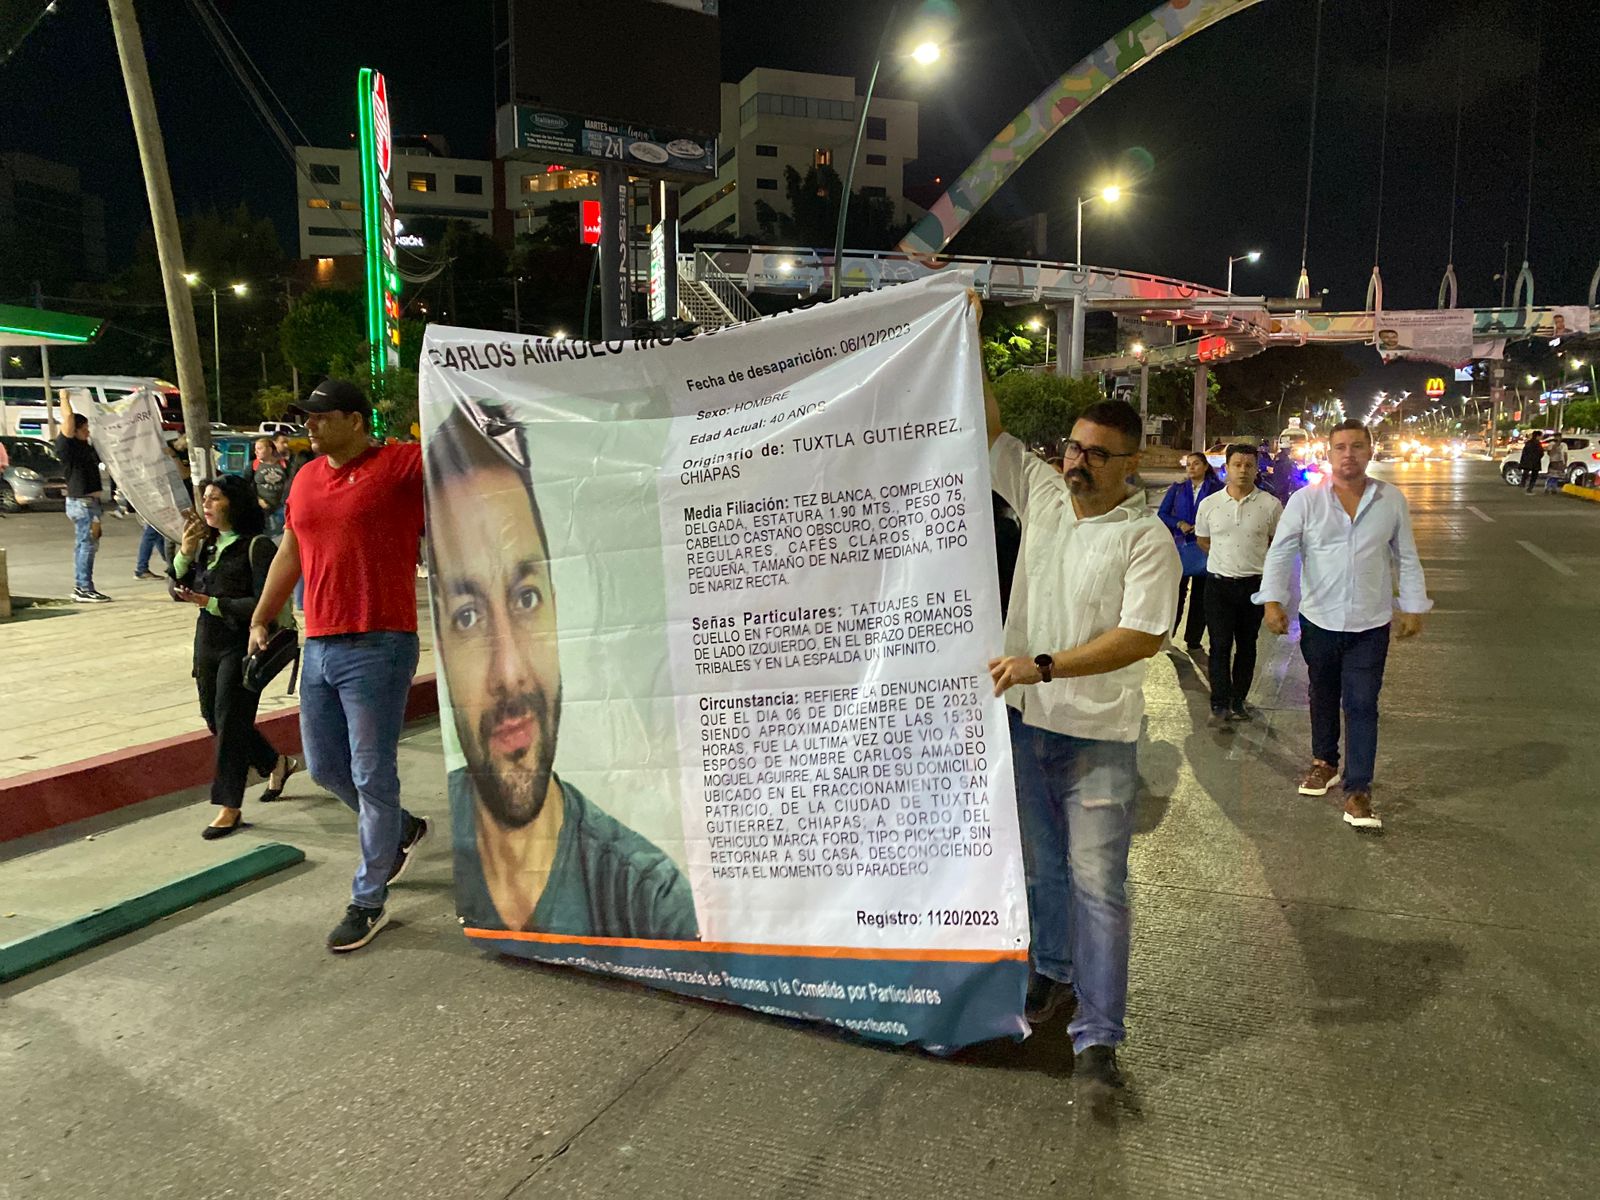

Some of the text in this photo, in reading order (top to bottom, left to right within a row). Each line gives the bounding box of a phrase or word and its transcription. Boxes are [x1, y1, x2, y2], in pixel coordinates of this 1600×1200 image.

[584, 119, 608, 132] MARTES
[686, 322, 912, 392] Fecha de desaparición: 06/12/2023
[696, 390, 790, 421] Sexo: HOMBRE
[689, 400, 826, 445] Edad Actual: 40 AÑOS
[682, 447, 753, 470] Originario
[761, 442, 784, 457] de:
[792, 432, 855, 452] TUXTLA
[680, 464, 740, 485] CHIAPAS
[683, 504, 722, 521] Media
[726, 496, 789, 516] Filiación:
[793, 493, 818, 508] TEZ
[879, 473, 963, 499] COMPLEXIÓN
[753, 507, 823, 528] ESTATURA
[829, 504, 856, 519] 1.90
[905, 492, 940, 511] PESO
[686, 532, 740, 551] CABELLO
[743, 524, 803, 544] CASTAÑO
[930, 503, 965, 520] OJOS
[788, 535, 837, 554] CAFÉS
[925, 519, 967, 537] BOCA
[751, 554, 805, 572] TAMAÑO
[808, 552, 827, 567] DE
[830, 544, 871, 564] NARIZ
[935, 533, 968, 550] TIPO
[689, 581, 705, 594] DE
[707, 577, 743, 592] NARIZ
[692, 589, 971, 631] Señas Particulares: TATUAJES EN EL
[692, 604, 972, 646] CUELLO EN FORMA DE NUMEROS ROMANOS
[694, 647, 712, 660] DE
[713, 644, 746, 659] LADO
[823, 636, 841, 649] EN
[844, 634, 861, 647] EL
[864, 627, 904, 645] BRAZO
[907, 620, 974, 640] DERECHO
[695, 658, 751, 675] TRIBALES
[753, 657, 762, 670] Y
[765, 656, 782, 669] EN
[784, 655, 801, 668] LA
[803, 649, 862, 666] ESPALDA
[864, 647, 880, 660] UN
[699, 675, 978, 711] Circunstancia: REFIERE DENUNCIANTE
[700, 711, 727, 727] QUE
[730, 710, 749, 725] EL
[756, 709, 779, 723] DIA
[785, 707, 801, 720] 06
[808, 705, 826, 719] DE
[833, 698, 907, 717] DICIEMBRE
[915, 696, 935, 710] DE
[701, 726, 750, 742] SIENDO
[758, 714, 896, 738] APROXIMADAMENTE
[905, 712, 933, 727] LAS
[753, 739, 778, 753] FUE
[783, 739, 799, 752] LA
[803, 734, 848, 750] ULTIMA
[851, 732, 879, 747] VEZ
[883, 729, 912, 745] QUE
[917, 727, 943, 742] VIO
[949, 726, 959, 740] A
[964, 724, 984, 739] SU
[702, 740, 986, 772] ESPOSO DE NOMBRE CARLOS AMADEO
[703, 772, 754, 787] MOGUEL
[815, 768, 830, 782] AL
[833, 764, 870, 780] SALIR
[872, 763, 891, 778] DE
[894, 762, 913, 777] SU
[916, 757, 987, 775] DOMICILIO
[704, 774, 988, 803] UBICADO EN EL FRACCIONAMIENTO SAN
[780, 800, 799, 815] DE
[808, 800, 826, 814] LA
[834, 796, 890, 813] CIUDAD
[900, 795, 921, 809] DE
[930, 792, 989, 808] TUXTLA
[876, 813, 886, 827] A
[896, 810, 952, 826] BORDO
[960, 809, 990, 823] DEL
[707, 833, 770, 849] VEHICULO
[772, 832, 819, 847] MARCA
[866, 829, 899, 844] TIPO
[969, 825, 991, 840] SIN
[710, 849, 779, 864] RETORNAR
[783, 849, 793, 863] A
[798, 848, 815, 862] SU
[868, 842, 992, 860] DESCONOCIENDO
[711, 862, 853, 878] HASTA EL MOMENTO SU
[856, 909, 999, 928] Registro: 1120/2023
[869, 983, 942, 1006] Particulares
